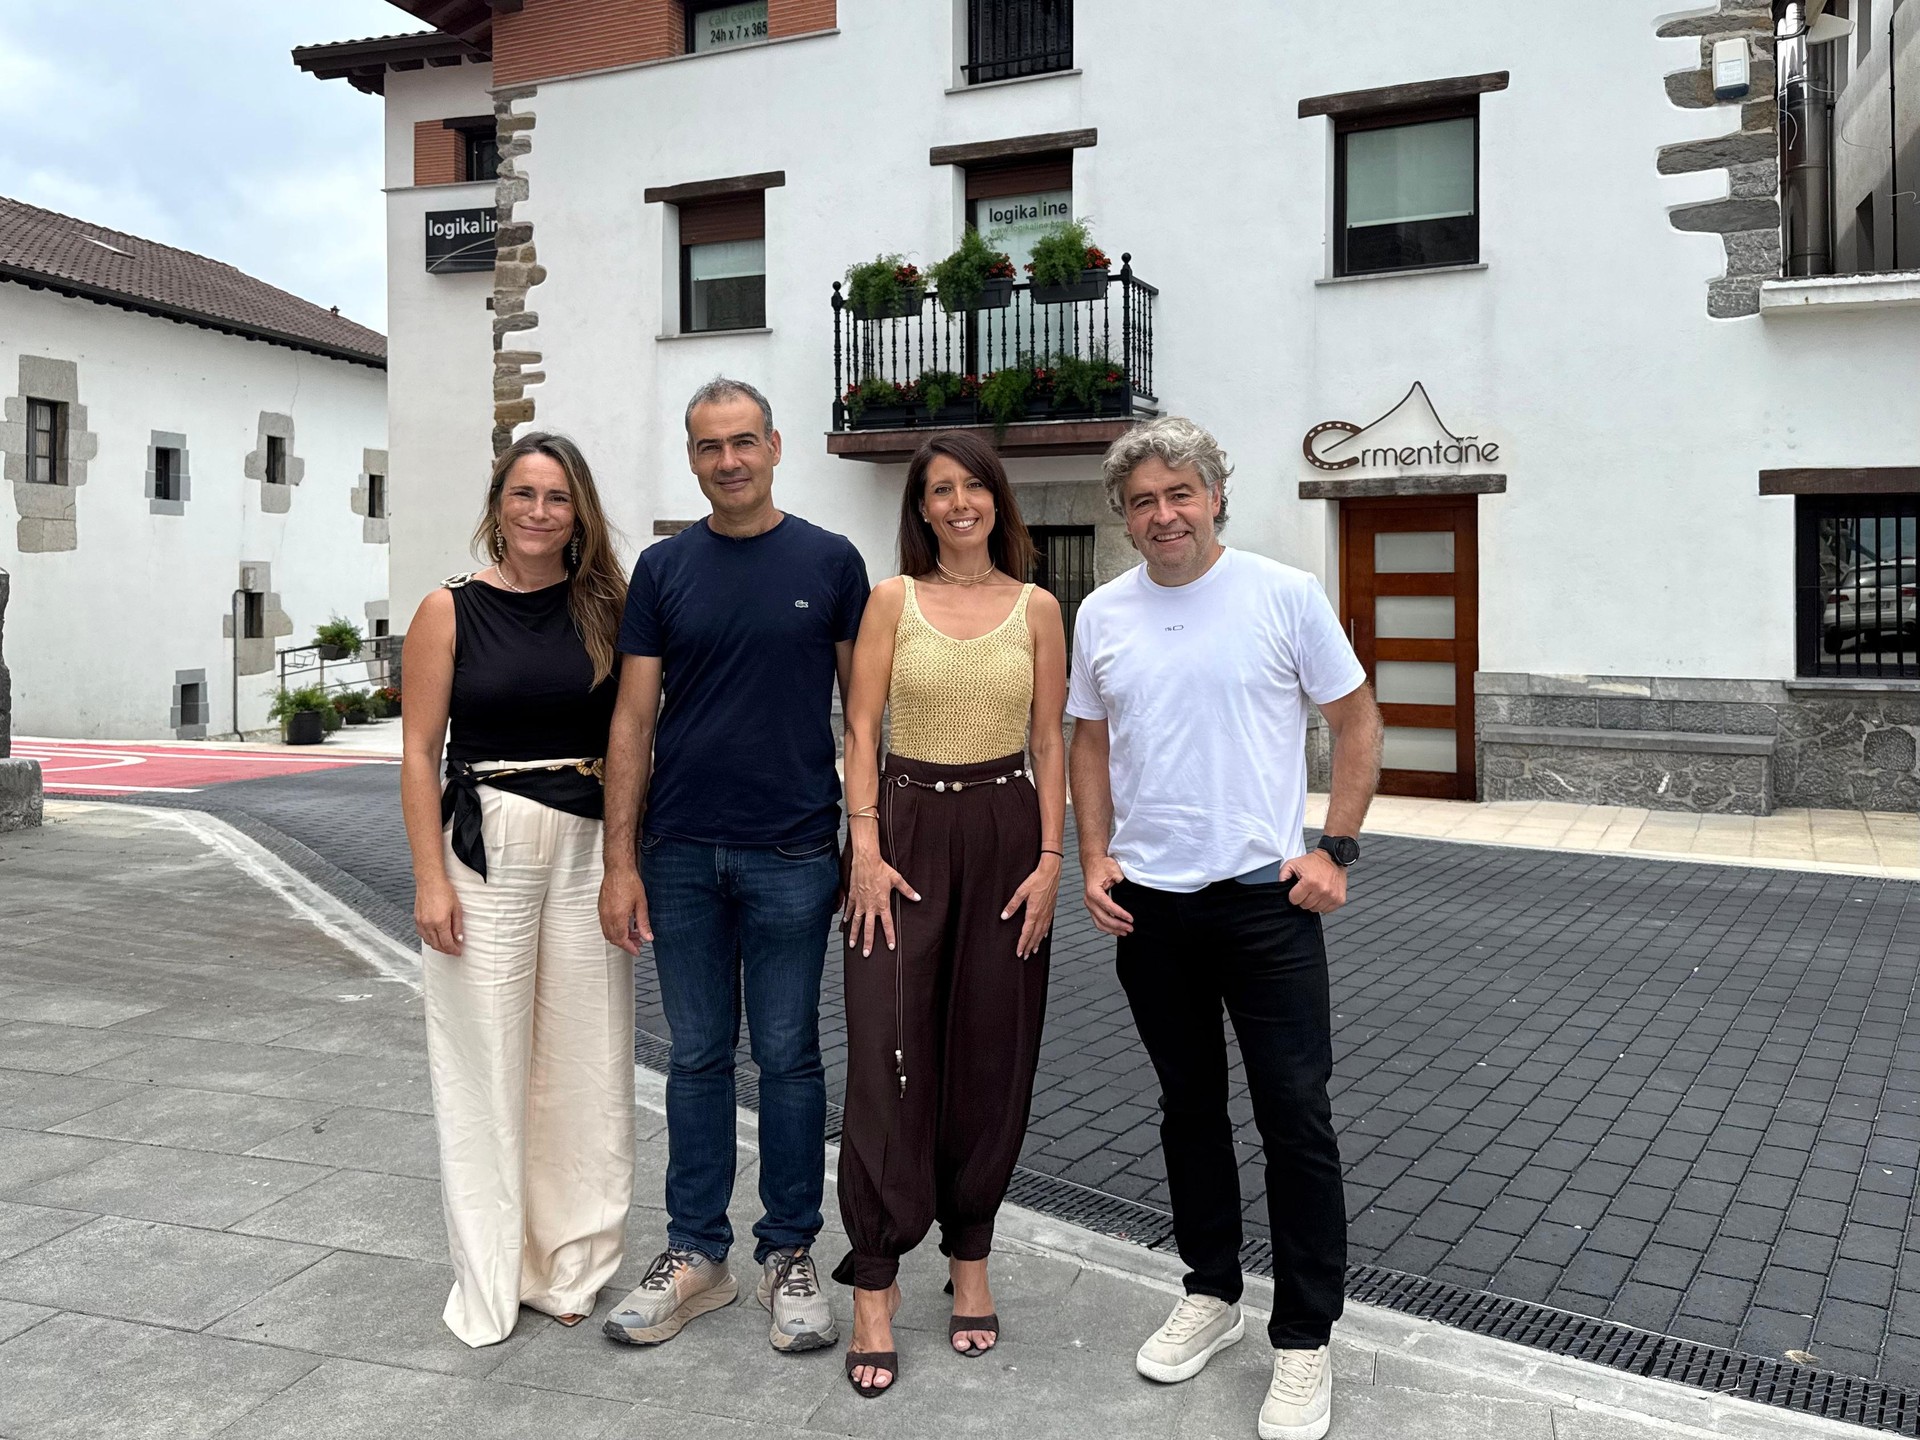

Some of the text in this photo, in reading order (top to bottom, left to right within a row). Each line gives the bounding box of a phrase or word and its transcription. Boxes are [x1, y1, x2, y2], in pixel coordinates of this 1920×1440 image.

[710, 21, 768, 43] 24h x 7 x 365
